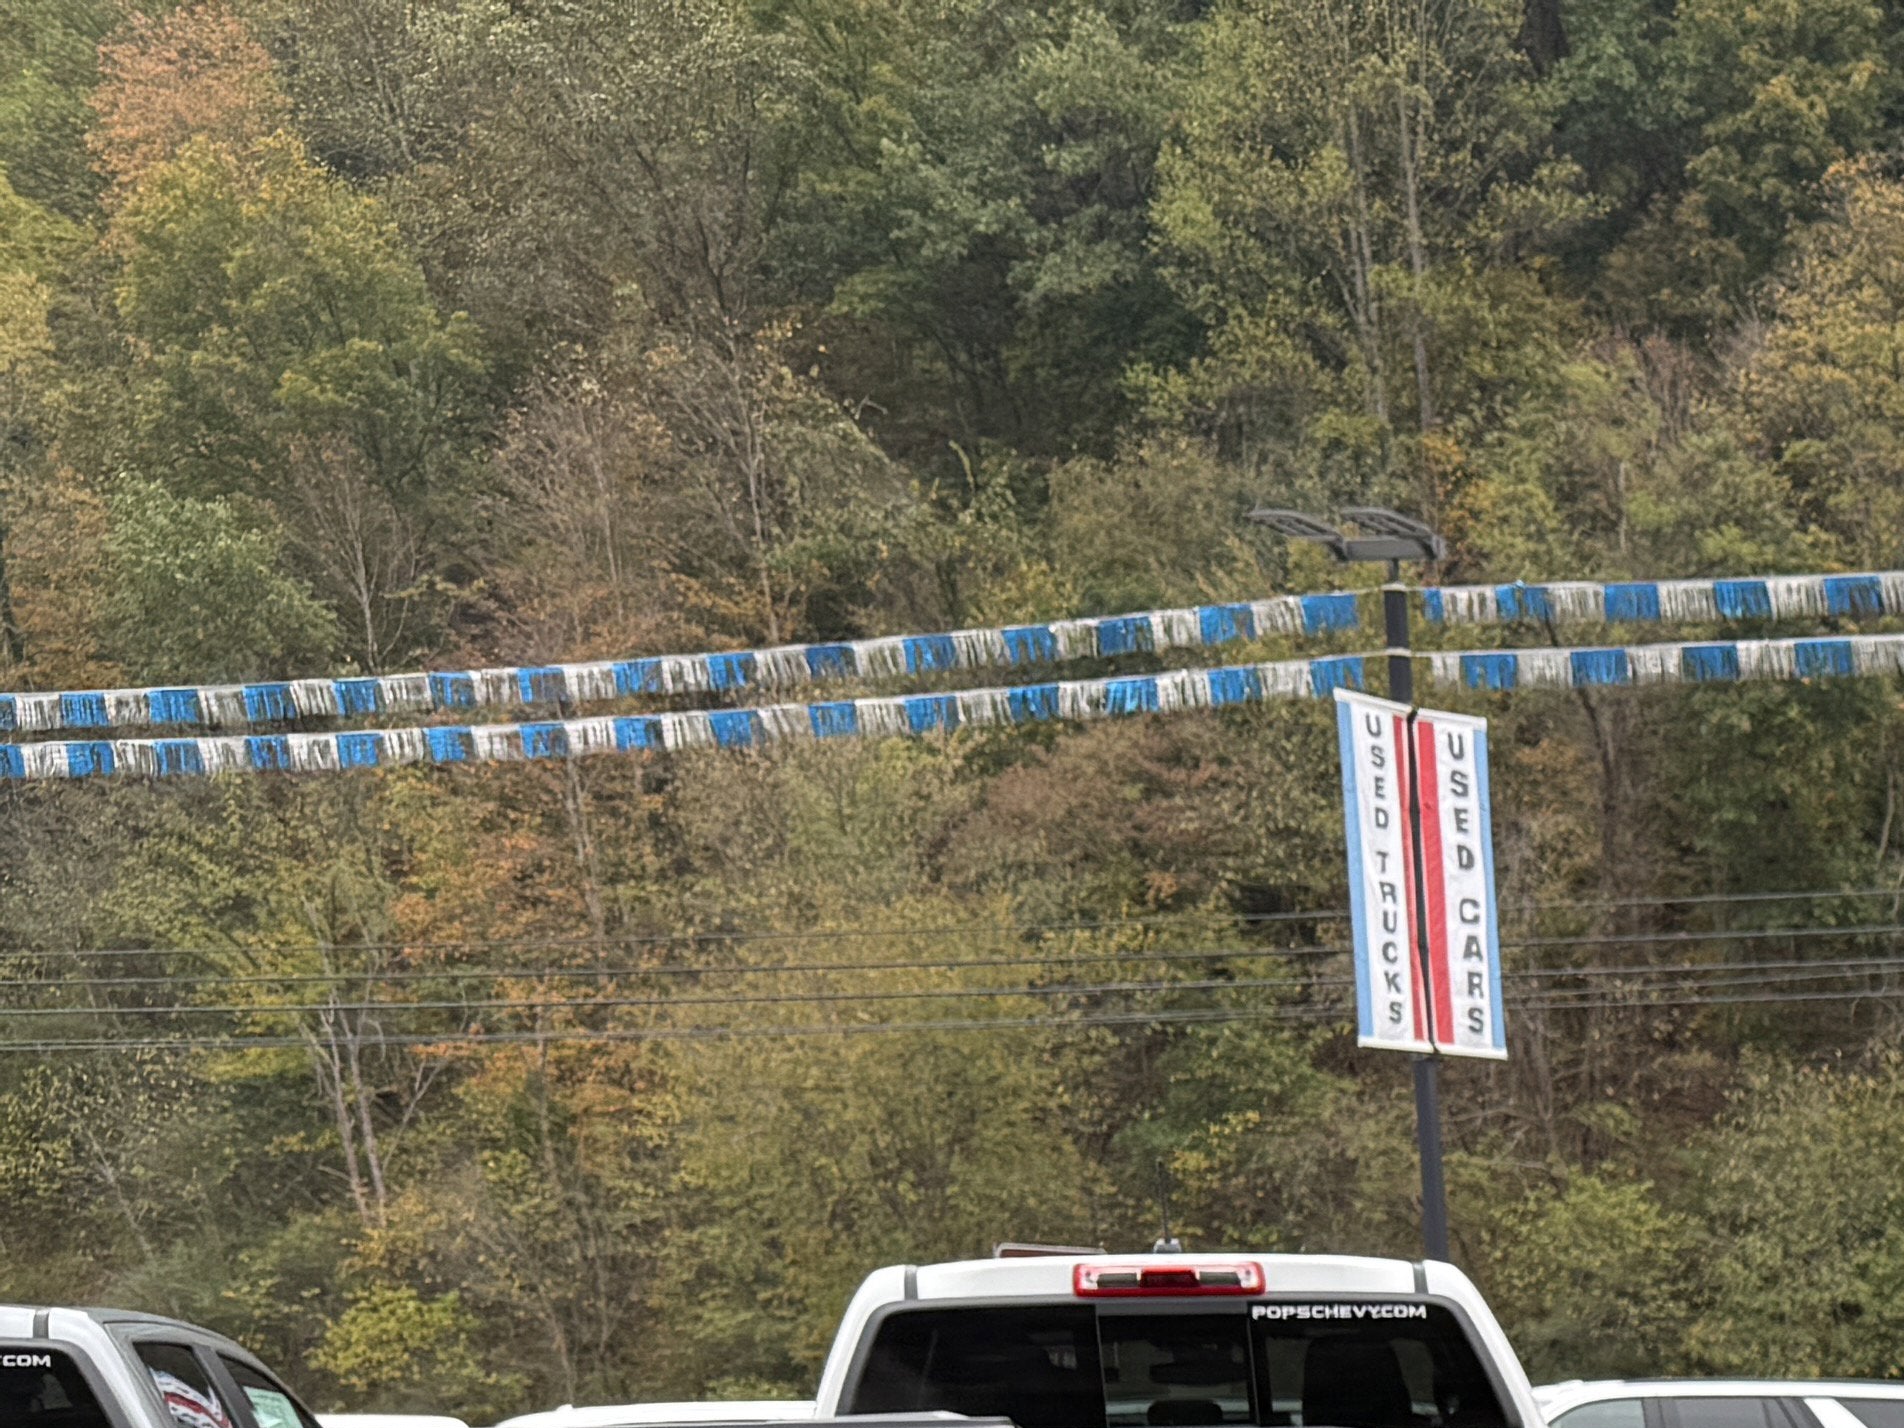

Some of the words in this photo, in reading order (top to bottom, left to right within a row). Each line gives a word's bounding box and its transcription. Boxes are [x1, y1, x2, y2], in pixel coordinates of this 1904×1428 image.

[1365, 712, 1390, 831] USED
[1447, 731, 1475, 872] USED
[1375, 850, 1405, 1026] TRUCKS
[1459, 896, 1485, 1036] CARS
